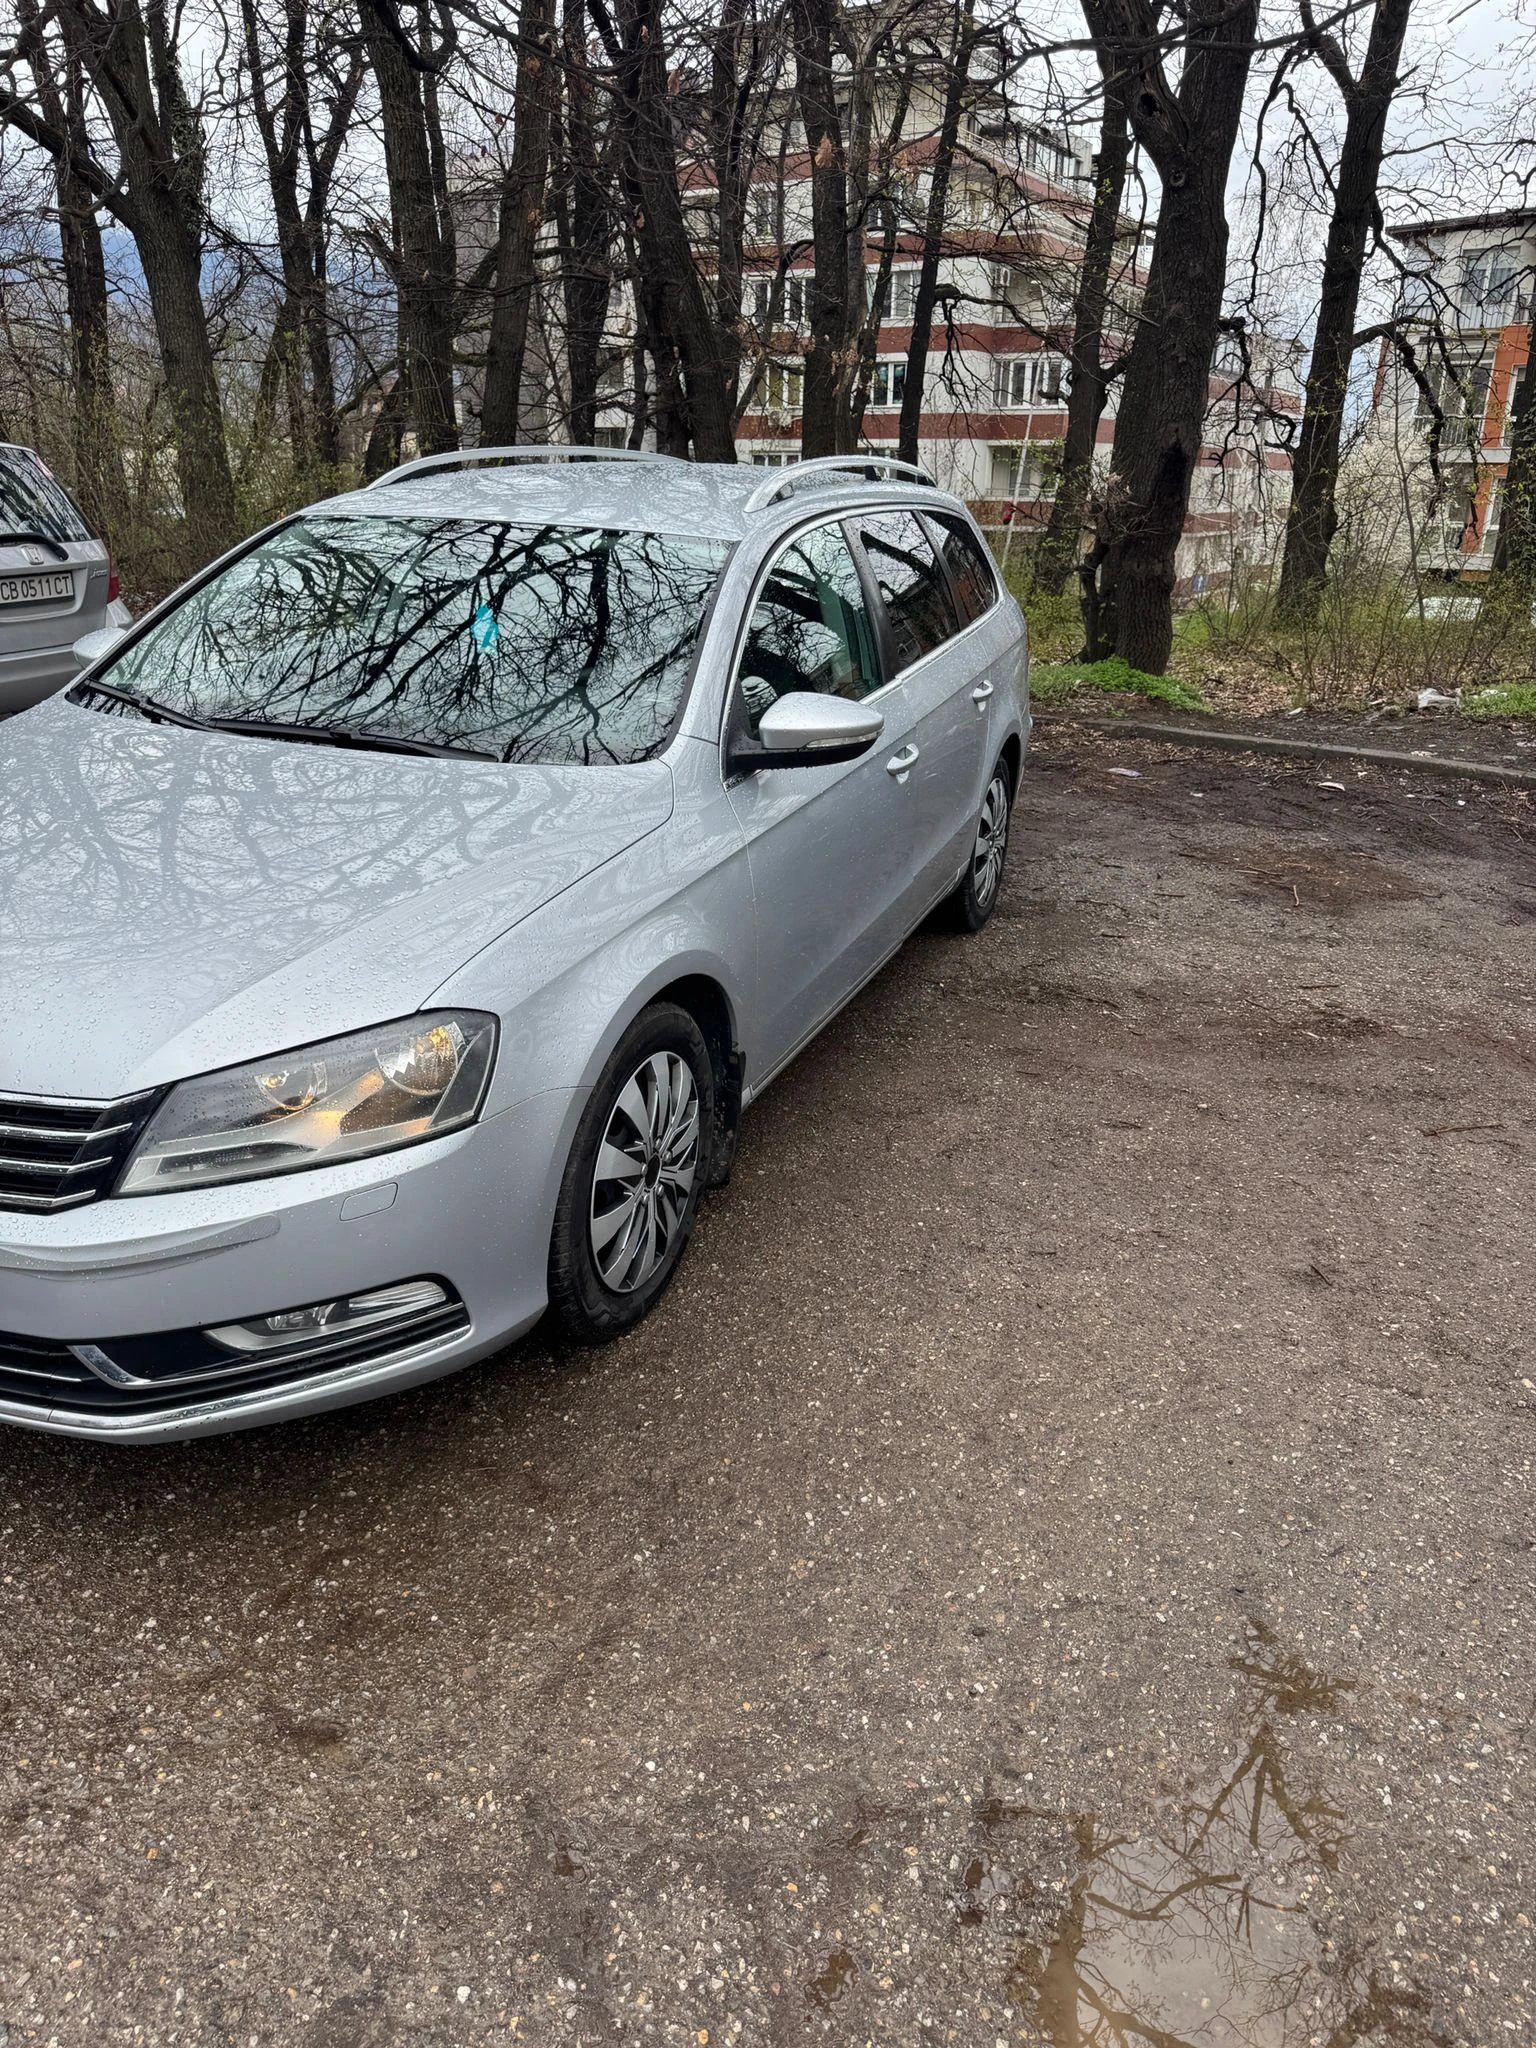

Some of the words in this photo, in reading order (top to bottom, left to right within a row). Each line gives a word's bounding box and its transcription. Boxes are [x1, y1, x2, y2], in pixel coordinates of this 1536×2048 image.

[0, 581, 19, 600] CB
[21, 577, 52, 598] 0511
[54, 575, 69, 594] CT
